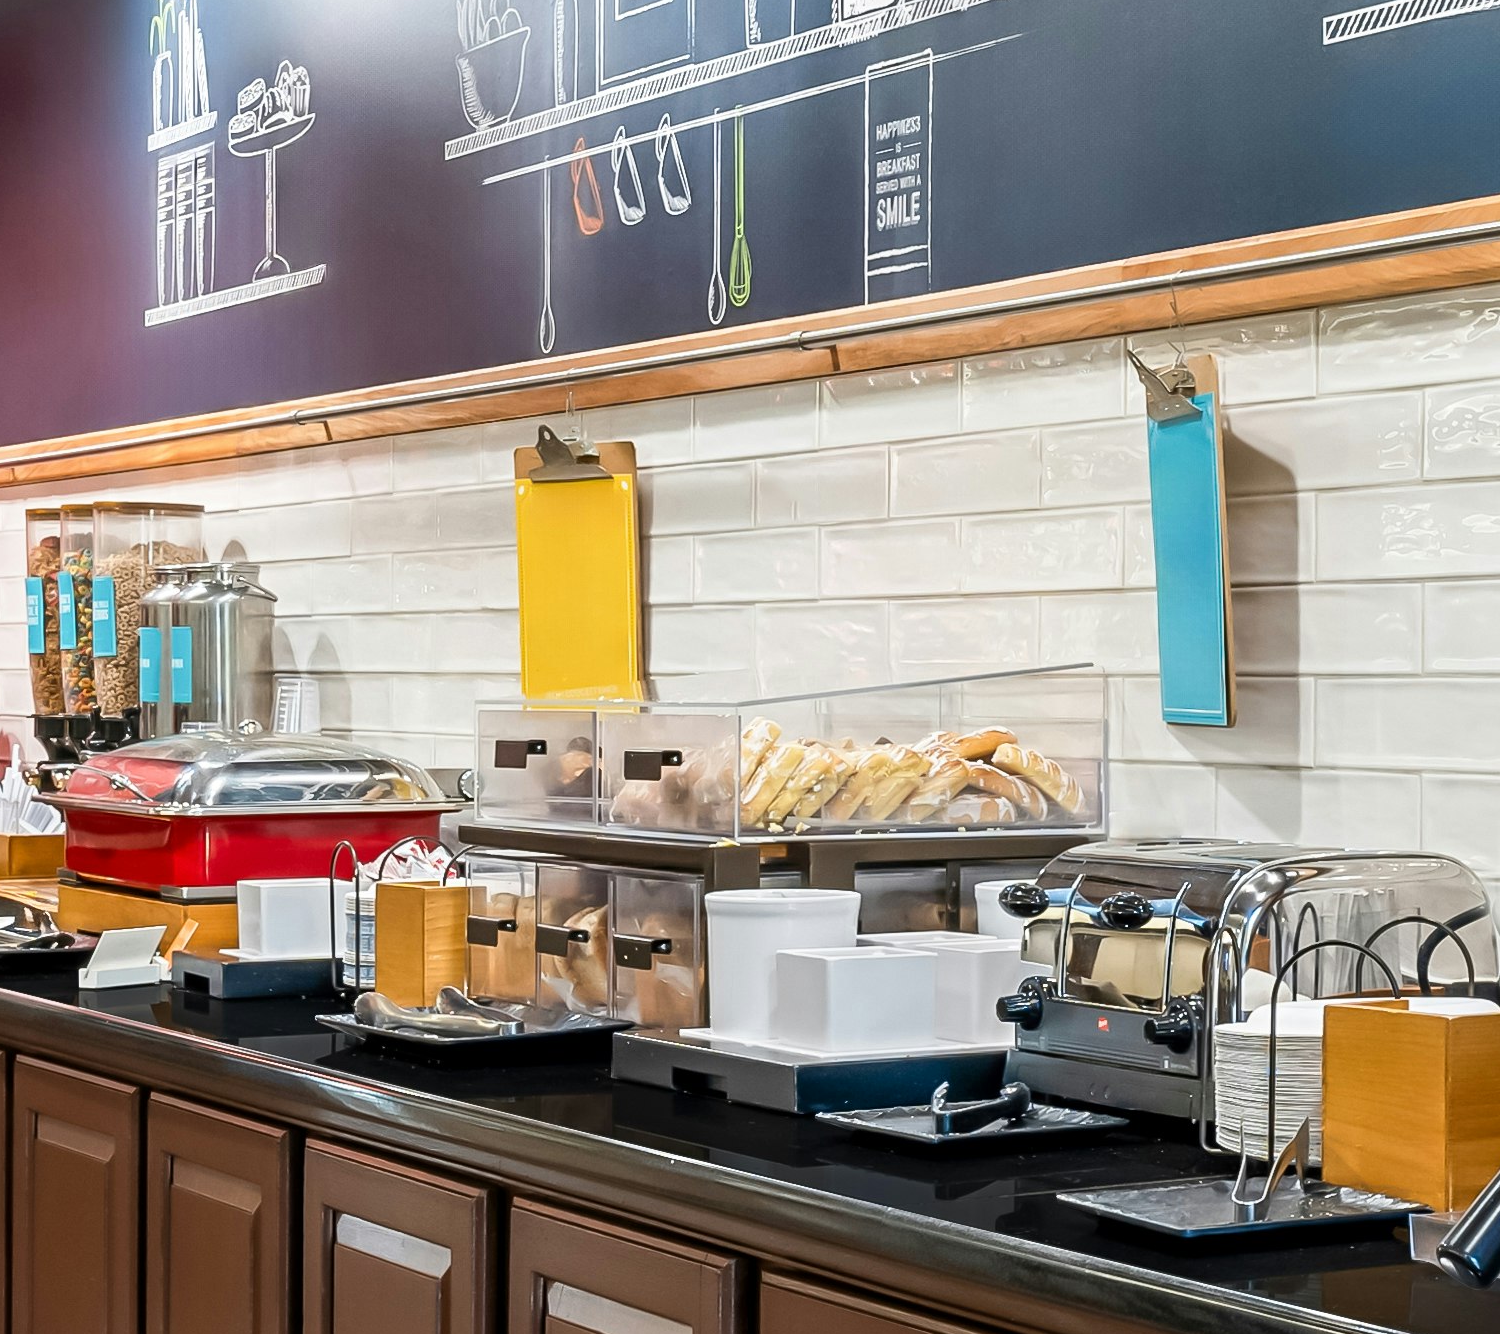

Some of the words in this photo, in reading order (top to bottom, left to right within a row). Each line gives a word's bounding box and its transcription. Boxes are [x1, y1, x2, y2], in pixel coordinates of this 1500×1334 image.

[876, 115, 921, 142] HAPPINESS
[876, 153, 921, 178] BREAKFAST
[916, 174, 921, 186] A
[876, 191, 921, 232] SMILE
